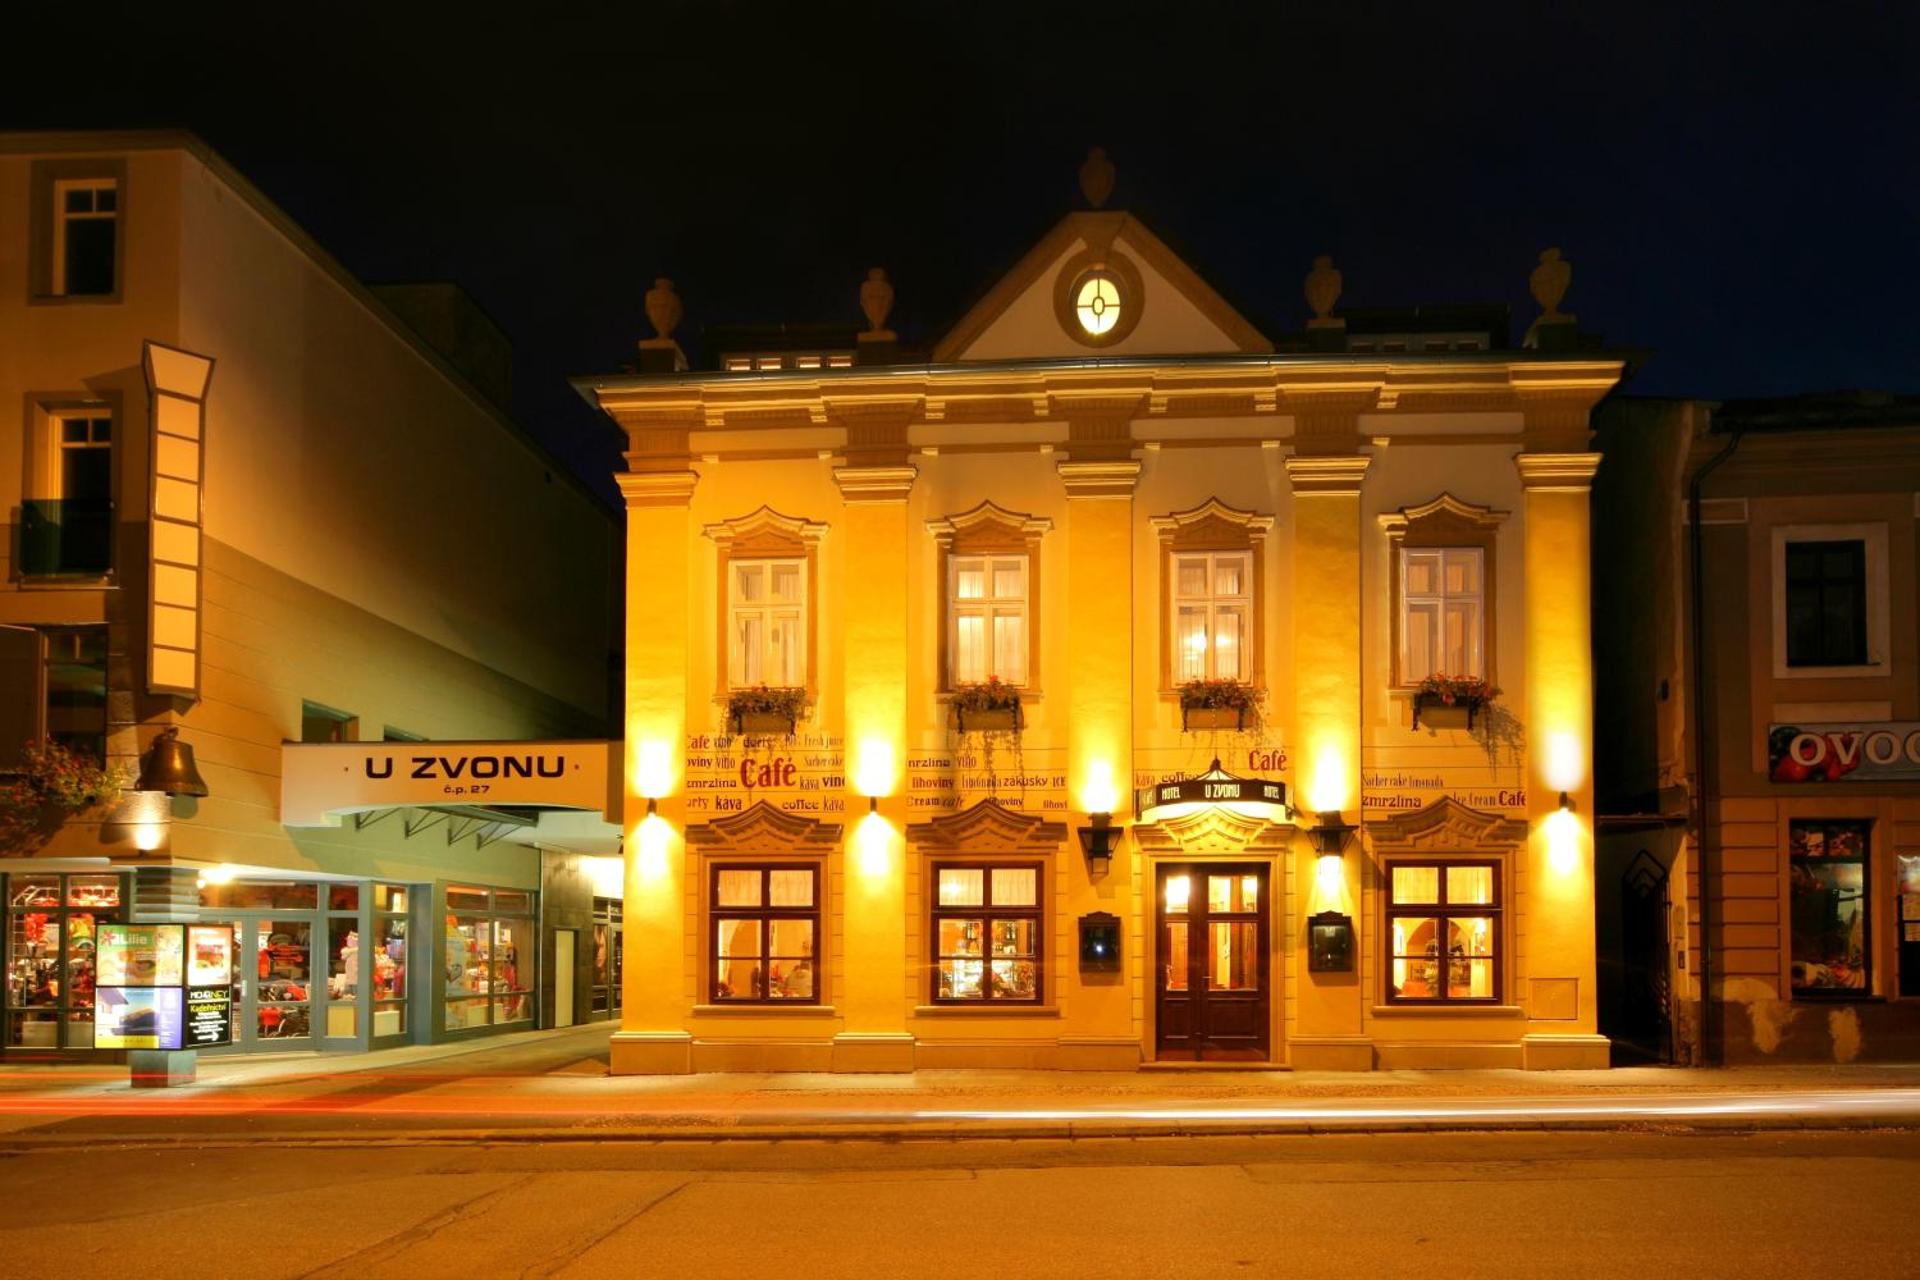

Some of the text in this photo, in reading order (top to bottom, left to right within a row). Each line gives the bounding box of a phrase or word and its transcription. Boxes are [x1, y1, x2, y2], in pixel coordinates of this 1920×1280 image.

[366, 756, 565, 779] U ZVONU
[1249, 750, 1287, 771] Café
[740, 757, 797, 788] Café
[444, 784, 490, 795] č.p. 27
[1162, 786, 1181, 800] HOTEL
[1205, 785, 1212, 798] U
[1213, 784, 1241, 798] ZVONU
[782, 799, 819, 810] coffee
